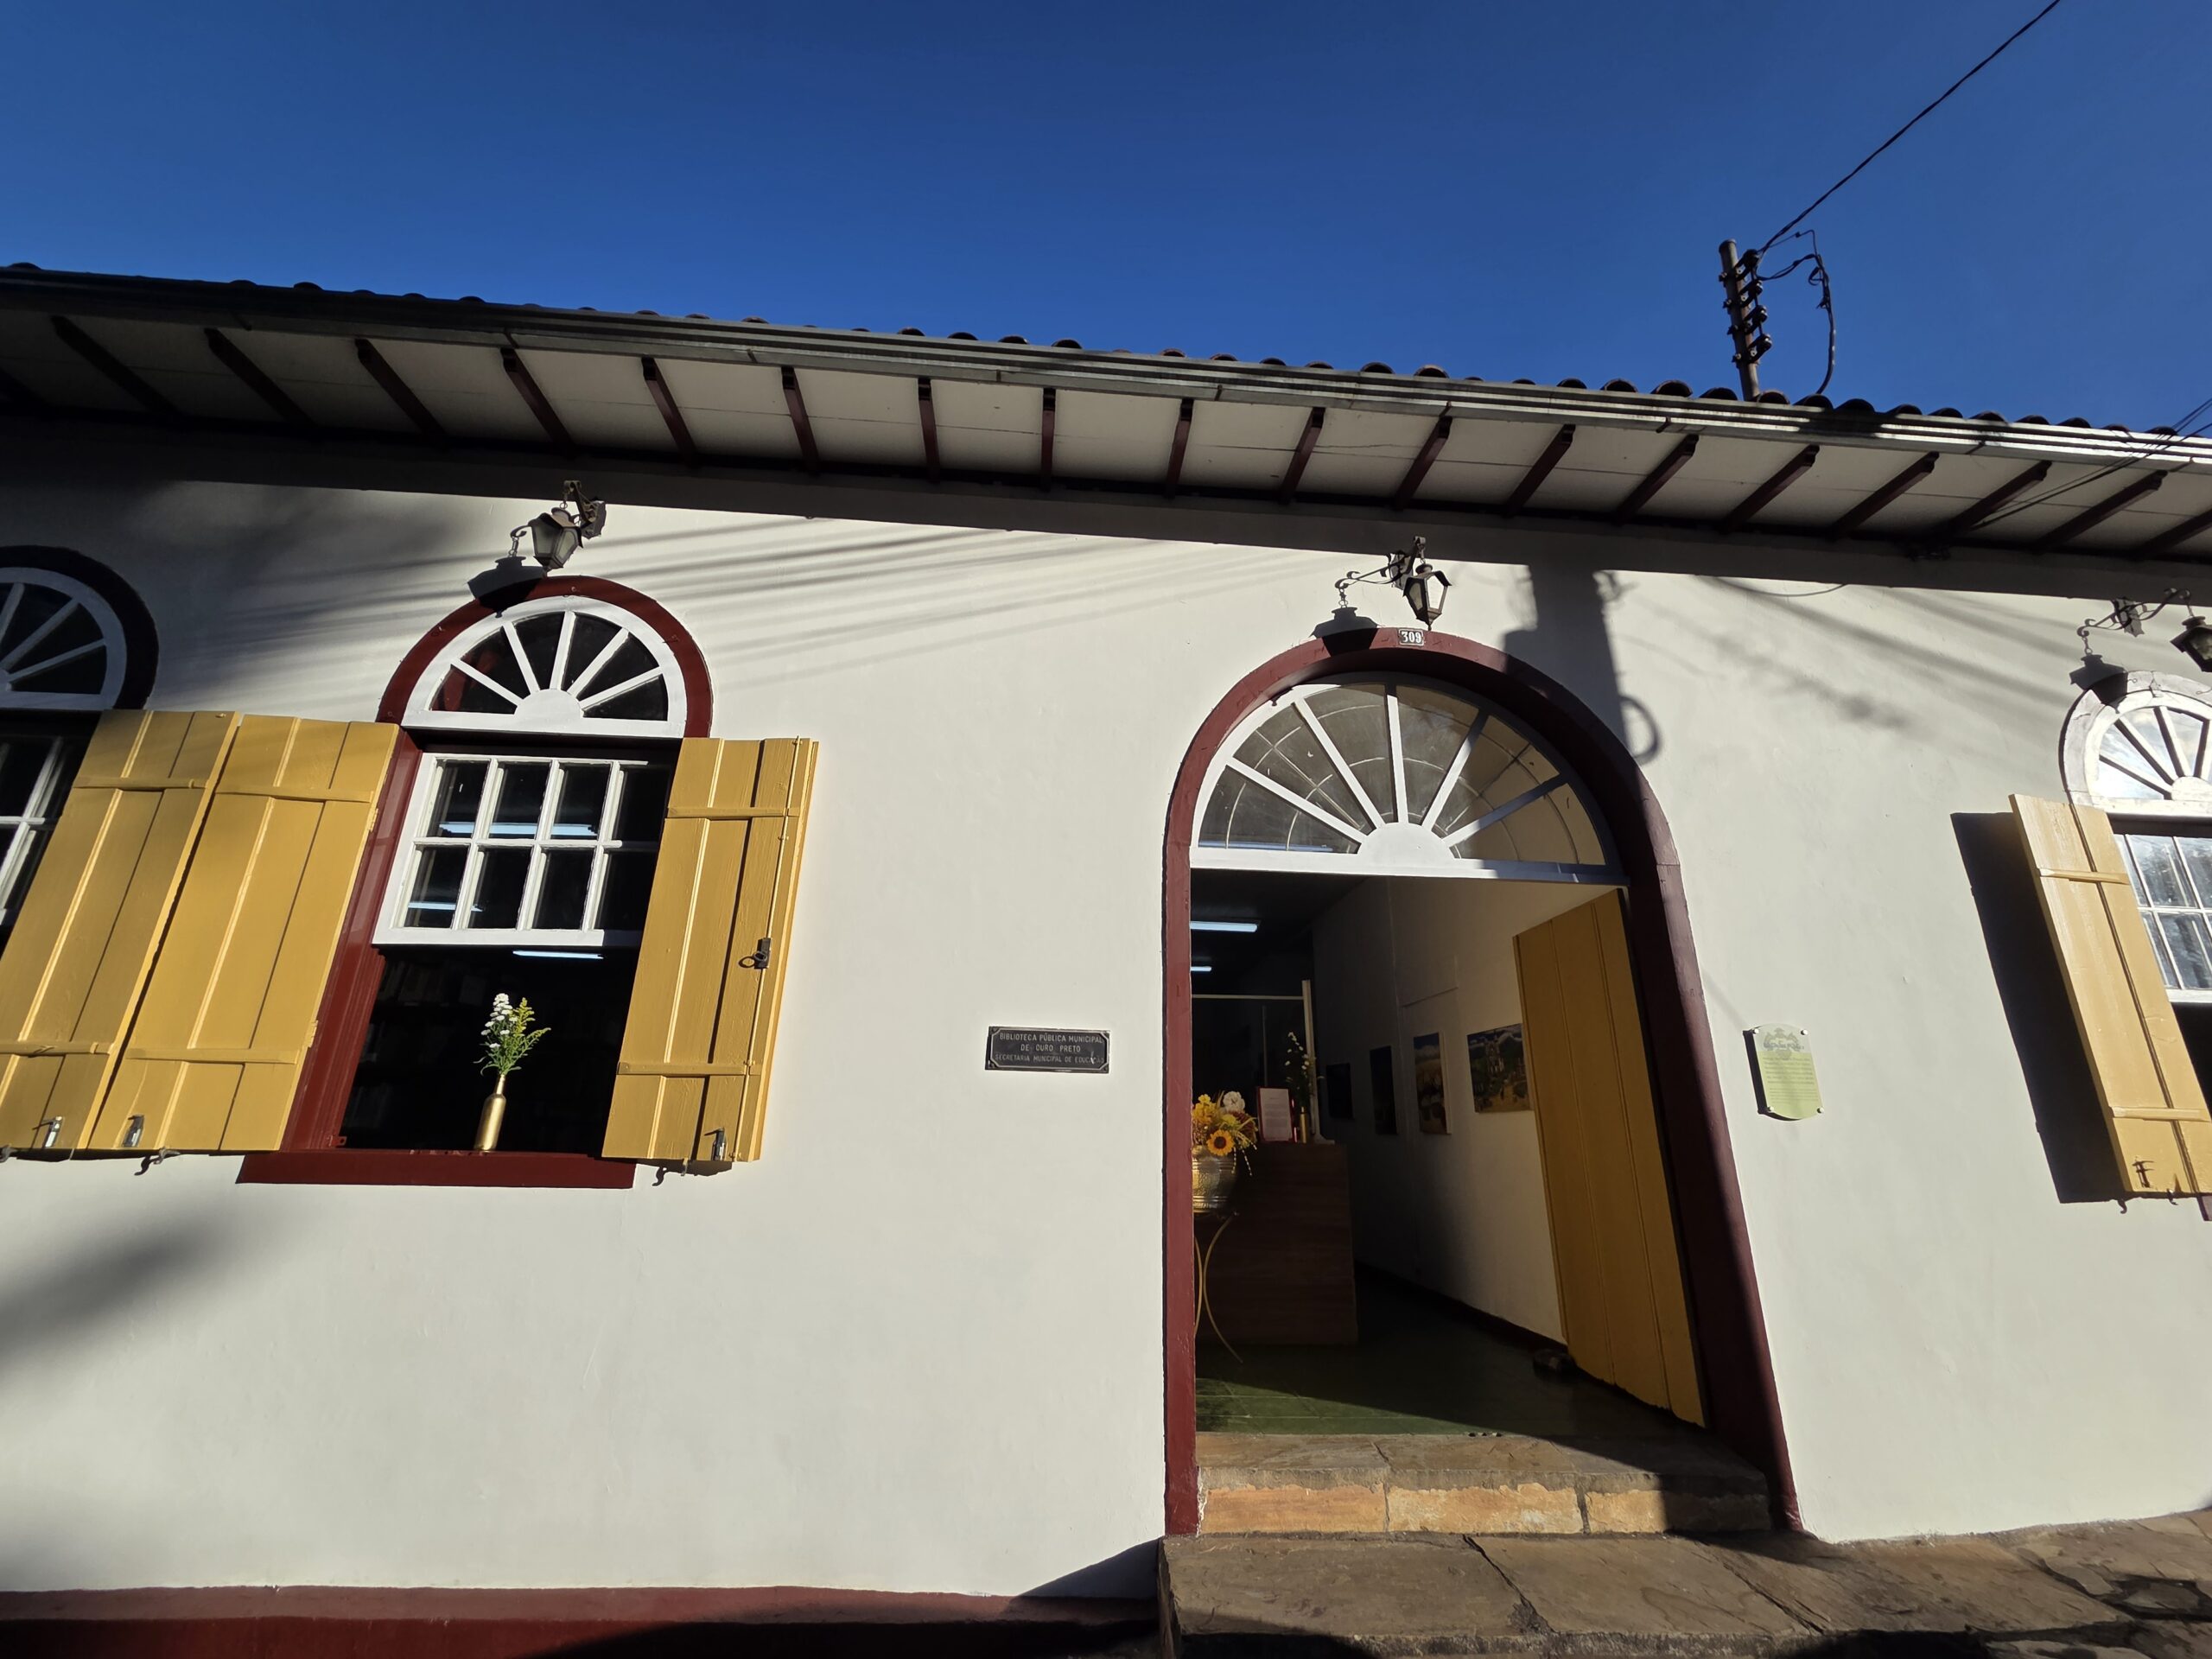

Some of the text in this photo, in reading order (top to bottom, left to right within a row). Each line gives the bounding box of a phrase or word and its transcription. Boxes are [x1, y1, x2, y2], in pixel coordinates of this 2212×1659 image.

[1401, 631, 1422, 643] 309
[999, 1033, 1103, 1044] BIBLIOTECA PÚBLICA MUNICIPAL
[995, 1053, 1030, 1062] SECRETARIA
[1033, 1054, 1062, 1063] MUNICIPAL
